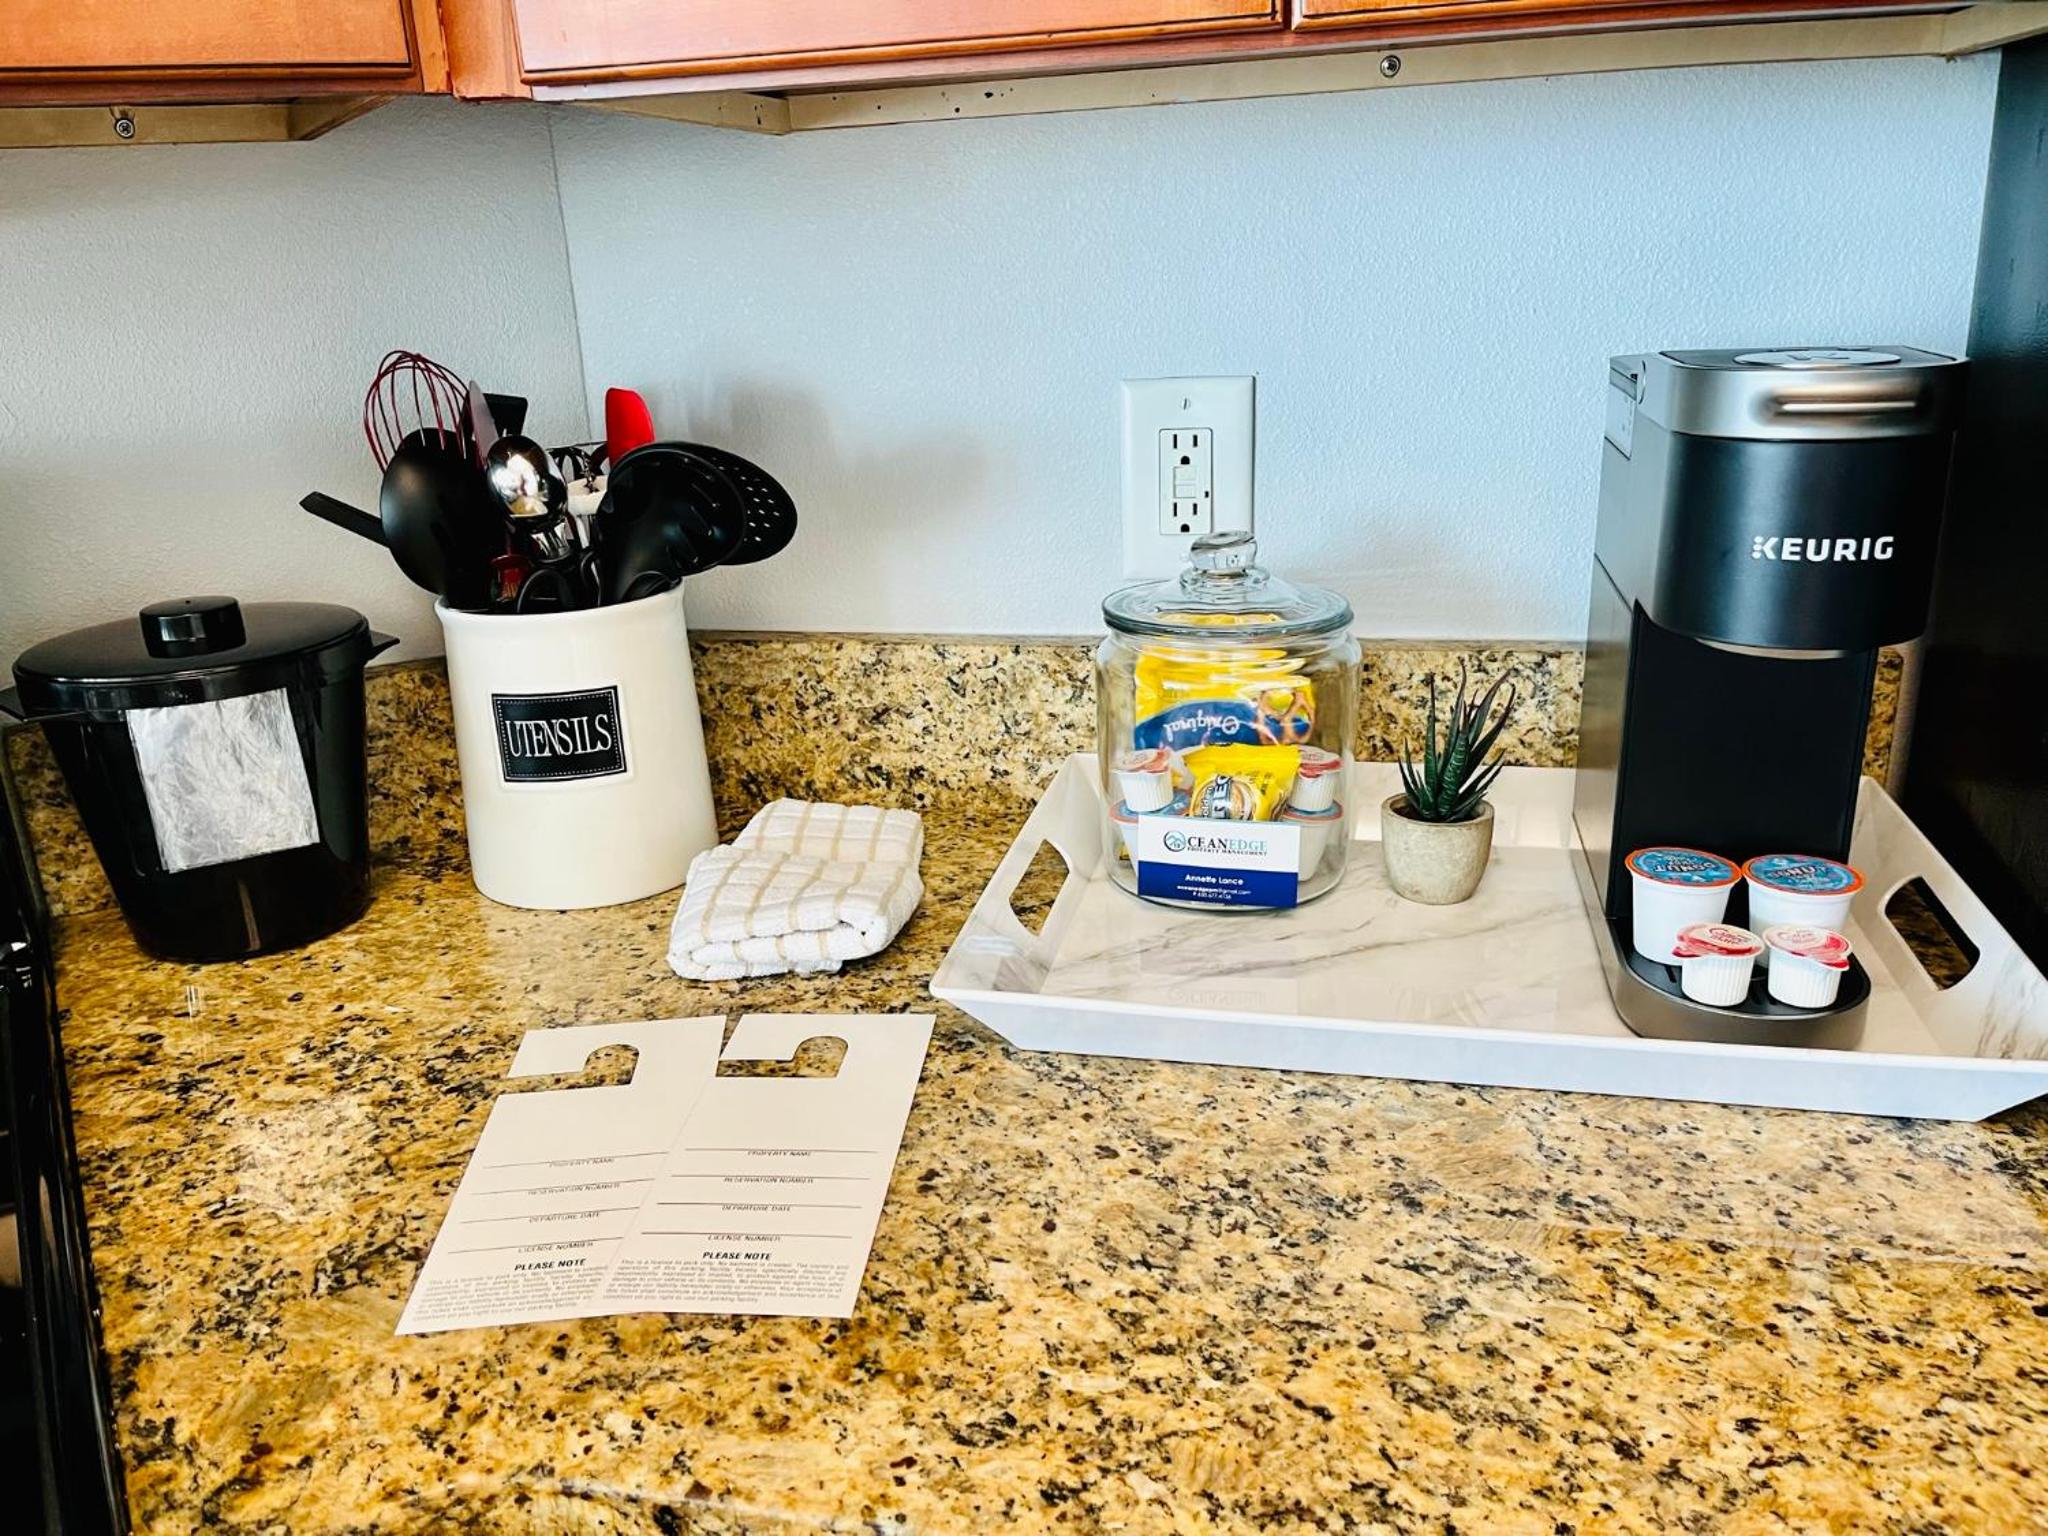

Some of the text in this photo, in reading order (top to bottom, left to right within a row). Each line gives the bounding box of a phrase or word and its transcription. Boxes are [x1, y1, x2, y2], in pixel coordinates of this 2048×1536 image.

[1751, 535, 1895, 562] KEURIG
[1165, 710, 1241, 741] Original
[504, 713, 612, 757] UTENSILS
[1184, 874, 1244, 886] Annette Lance
[707, 1234, 743, 1242] LICENSE
[702, 1251, 773, 1260] PLEASE NOTE
[514, 1258, 587, 1271] PLEASE NOTE
